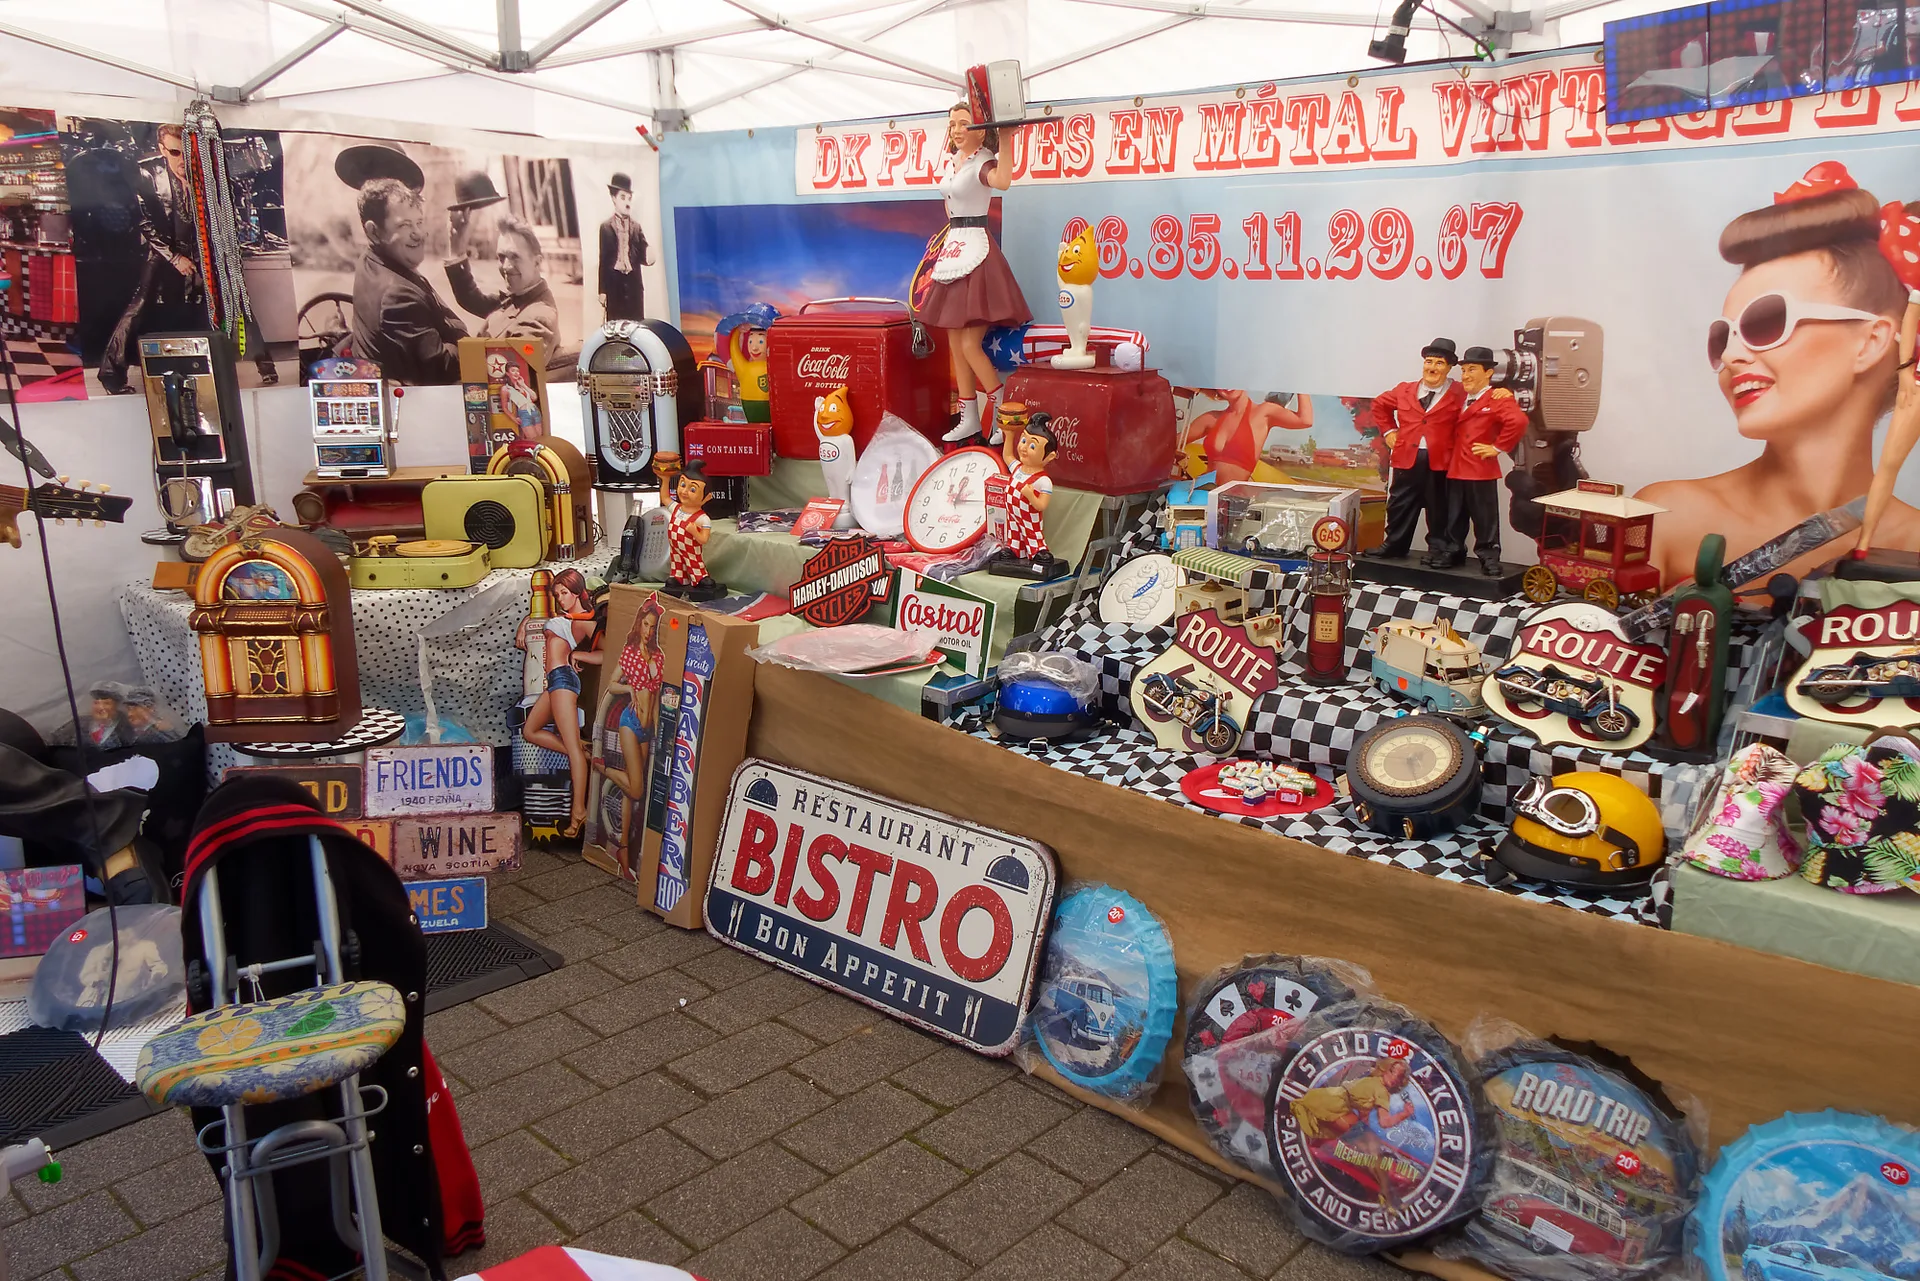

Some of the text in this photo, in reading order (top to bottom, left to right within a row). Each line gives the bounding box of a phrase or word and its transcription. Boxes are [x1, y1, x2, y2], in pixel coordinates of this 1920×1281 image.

[813, 129, 871, 189] DK
[877, 113, 1096, 188] PLUES
[1106, 106, 1184, 174] EN
[1194, 82, 1417, 170] MÉTAL
[797, 353, 852, 379] Coca-Cola
[323, 383, 371, 397] CASINO
[493, 432, 516, 442] GAS
[706, 445, 754, 455] CONTAINER
[949, 467, 958, 478] 11
[965, 462, 977, 474] 12
[982, 467, 987, 478] 1
[933, 480, 945, 491] 10
[922, 495, 931, 507] 9
[919, 512, 928, 524] 8
[974, 515, 982, 526] 4
[925, 526, 935, 537] 7
[939, 532, 948, 544] 6
[956, 527, 966, 539] 5
[1319, 528, 1341, 543] GAS
[807, 543, 859, 575] MOTOR
[792, 553, 879, 609] HARLEY-DAVIDSON
[812, 587, 863, 622] CYCLES
[900, 593, 983, 637] Castrol
[961, 639, 972, 649] OIL
[1179, 614, 1273, 693] ROUTE
[1526, 623, 1664, 684] ROUTE
[377, 756, 483, 793] FRIENDS
[660, 681, 699, 871] BARBER
[401, 794, 462, 806] 1940 PENNA
[792, 788, 976, 867] RESTAURANT
[418, 825, 498, 859] WINE
[403, 862, 437, 873] NOVA
[445, 858, 491, 870] SCOTIA
[410, 886, 465, 917] MES
[656, 873, 685, 911] HOP
[731, 808, 1014, 983] BISTRO
[420, 918, 459, 928] ZUELA
[755, 913, 950, 1018] BON APPETIT
[1511, 1071, 1596, 1127] ROAD
[1593, 1095, 1651, 1148] TRIP
[1333, 1139, 1421, 1183] MECHANIC ON DUTY
[1616, 1154, 1638, 1170] 20€
[1881, 1165, 1907, 1182] 20€
[1310, 1186, 1352, 1223] AND
[1358, 1189, 1442, 1231] SERVICE
